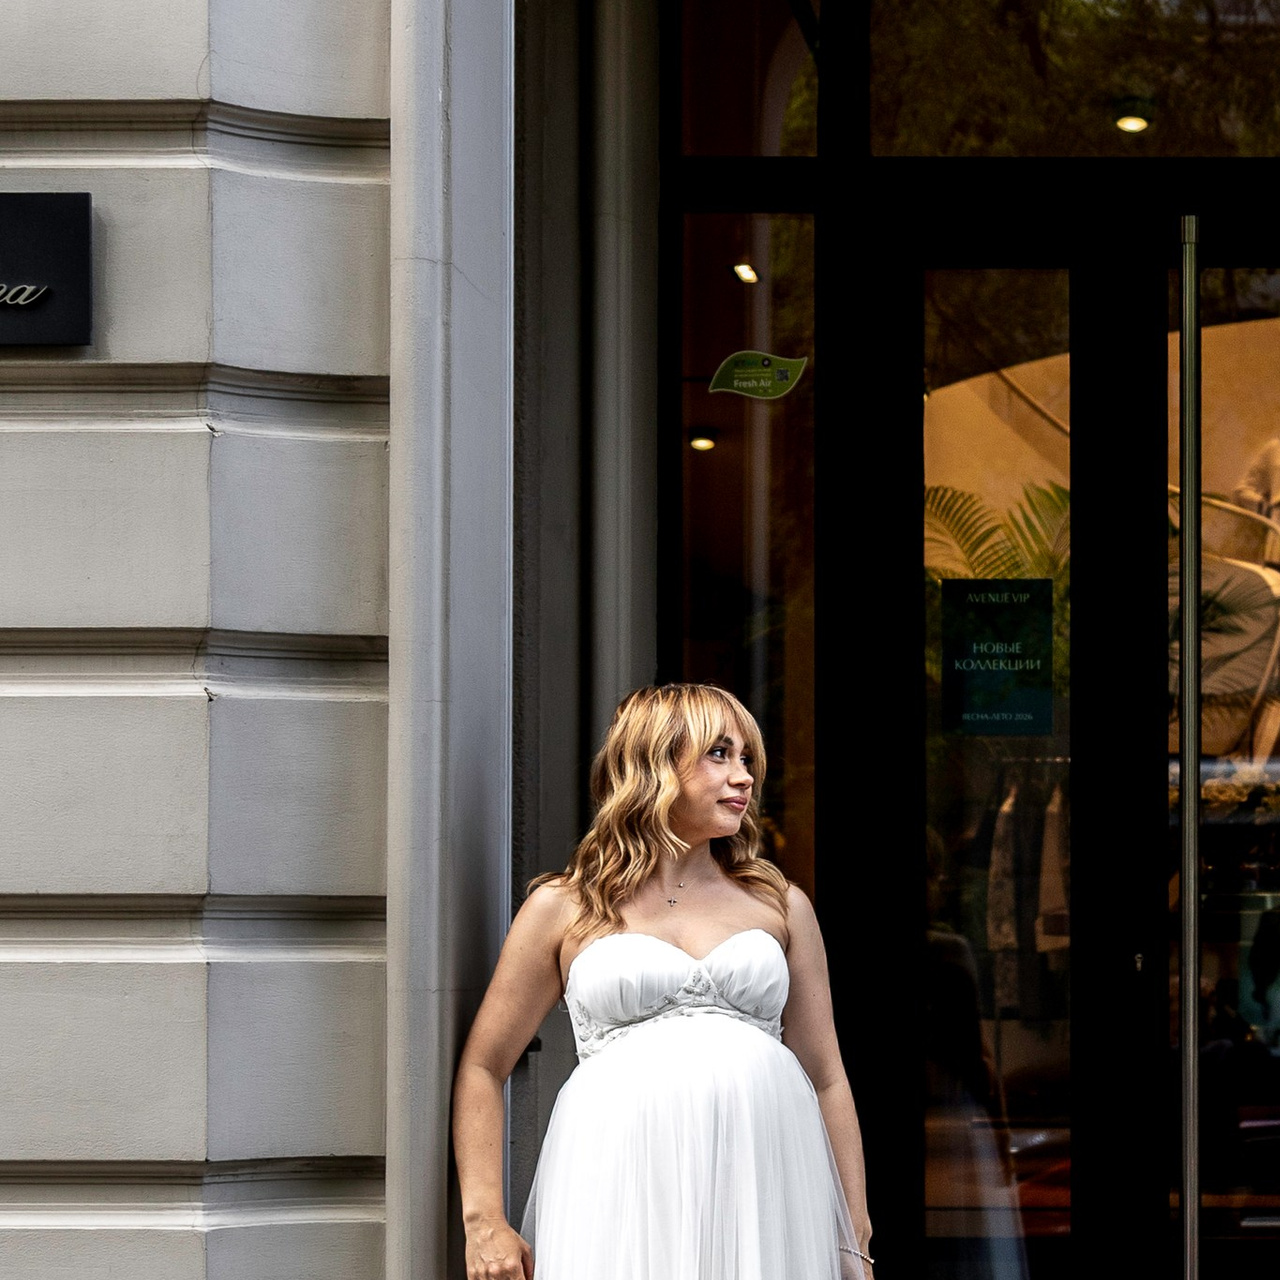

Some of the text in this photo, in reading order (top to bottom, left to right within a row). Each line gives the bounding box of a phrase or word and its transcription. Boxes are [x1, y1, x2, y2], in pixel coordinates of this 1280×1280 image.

[733, 379, 772, 388] Fresh Air
[966, 592, 1030, 603] AVENUE VIP
[973, 642, 1023, 654] НОВЫЕ
[954, 659, 1041, 670] КОЛЛЕКЦИИ
[962, 712, 1012, 721] ВЕСНА-ЛЕТО
